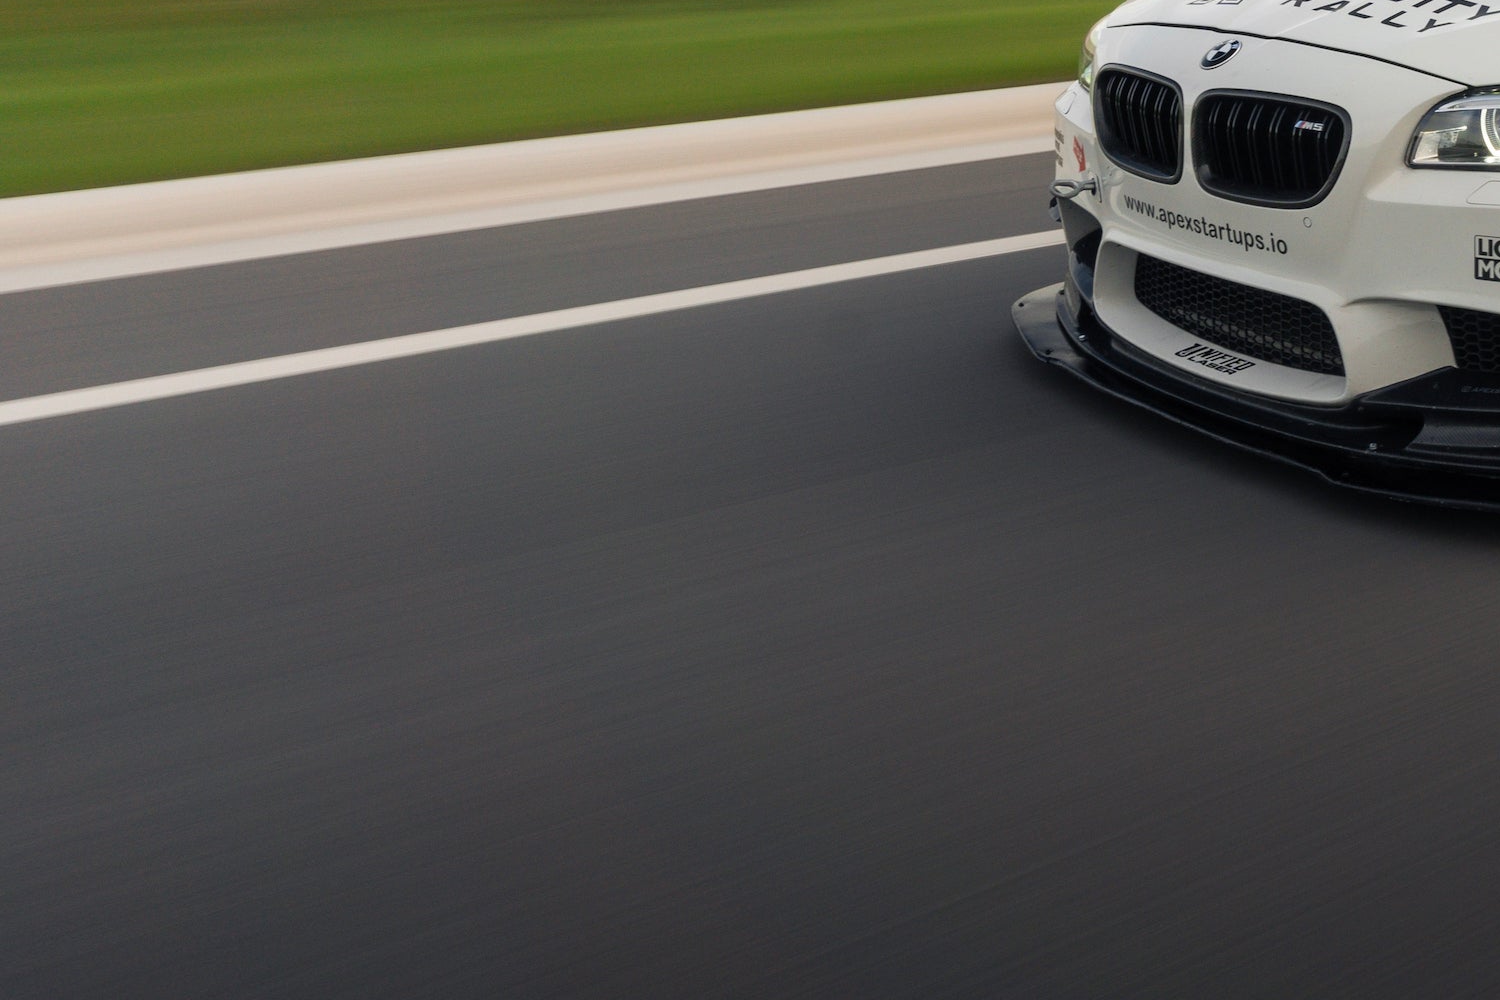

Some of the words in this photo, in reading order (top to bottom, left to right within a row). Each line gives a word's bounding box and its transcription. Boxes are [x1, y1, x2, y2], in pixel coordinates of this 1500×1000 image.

[1303, 120, 1325, 131] M5
[1123, 193, 1289, 255] www.apexstartups.io
[1174, 343, 1257, 371] UNIFIED
[1187, 355, 1238, 375] LASER
